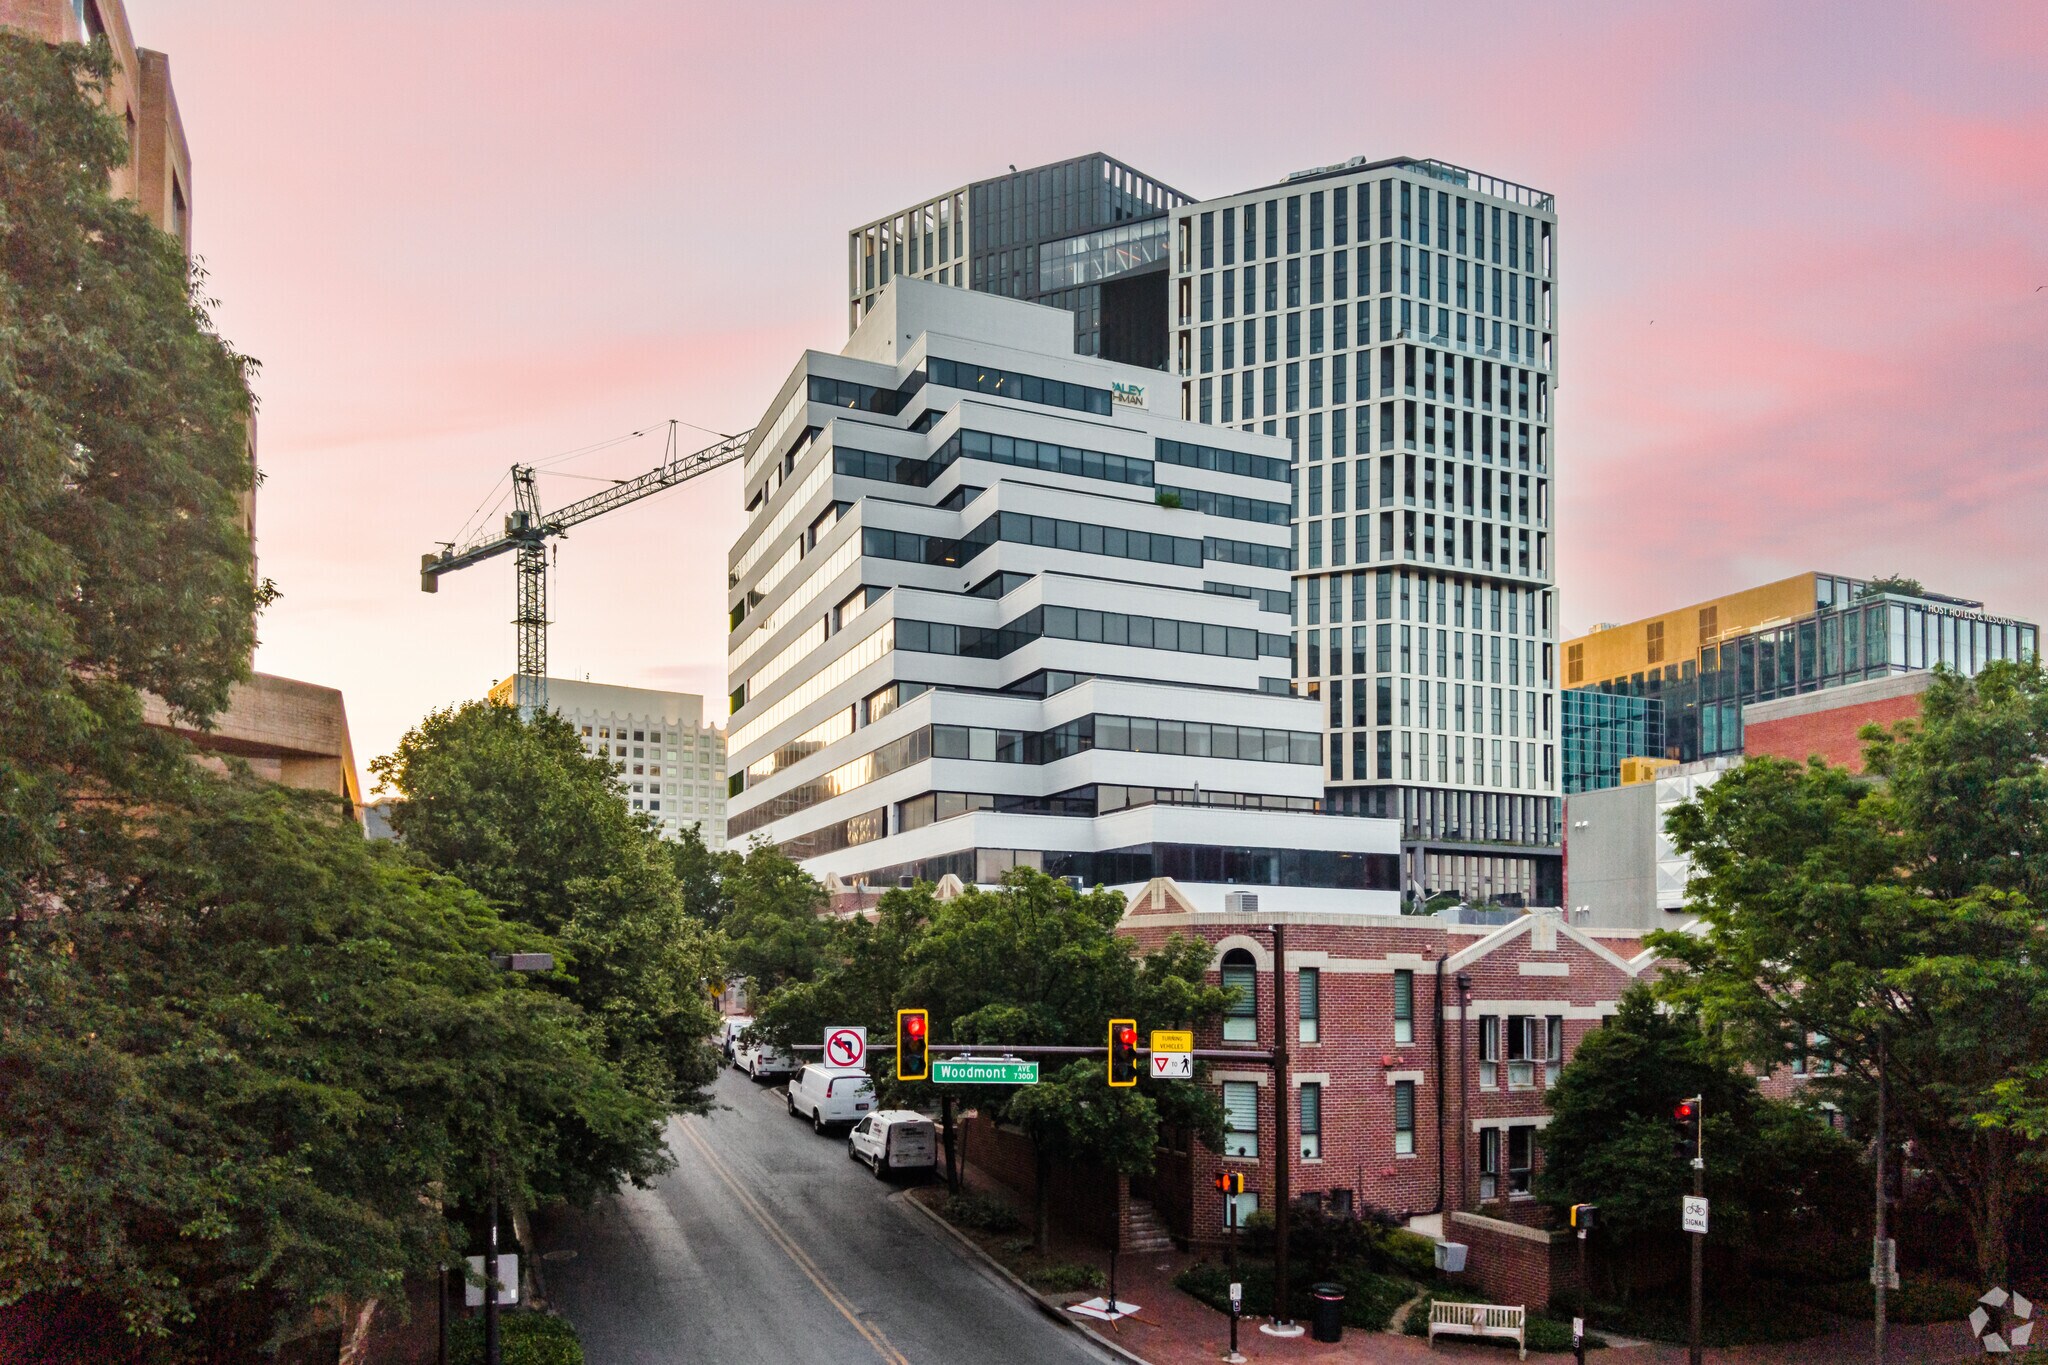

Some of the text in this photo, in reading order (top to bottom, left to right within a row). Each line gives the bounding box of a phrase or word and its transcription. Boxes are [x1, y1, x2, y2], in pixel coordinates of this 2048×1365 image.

[1928, 604, 1947, 615] HOST
[1949, 607, 1976, 620] HOTELS
[1984, 613, 2015, 627] RESORTS
[941, 1065, 1007, 1079] Woodmont
[1017, 1065, 1031, 1073] AVE
[1685, 1218, 1705, 1228] SIGNAL
